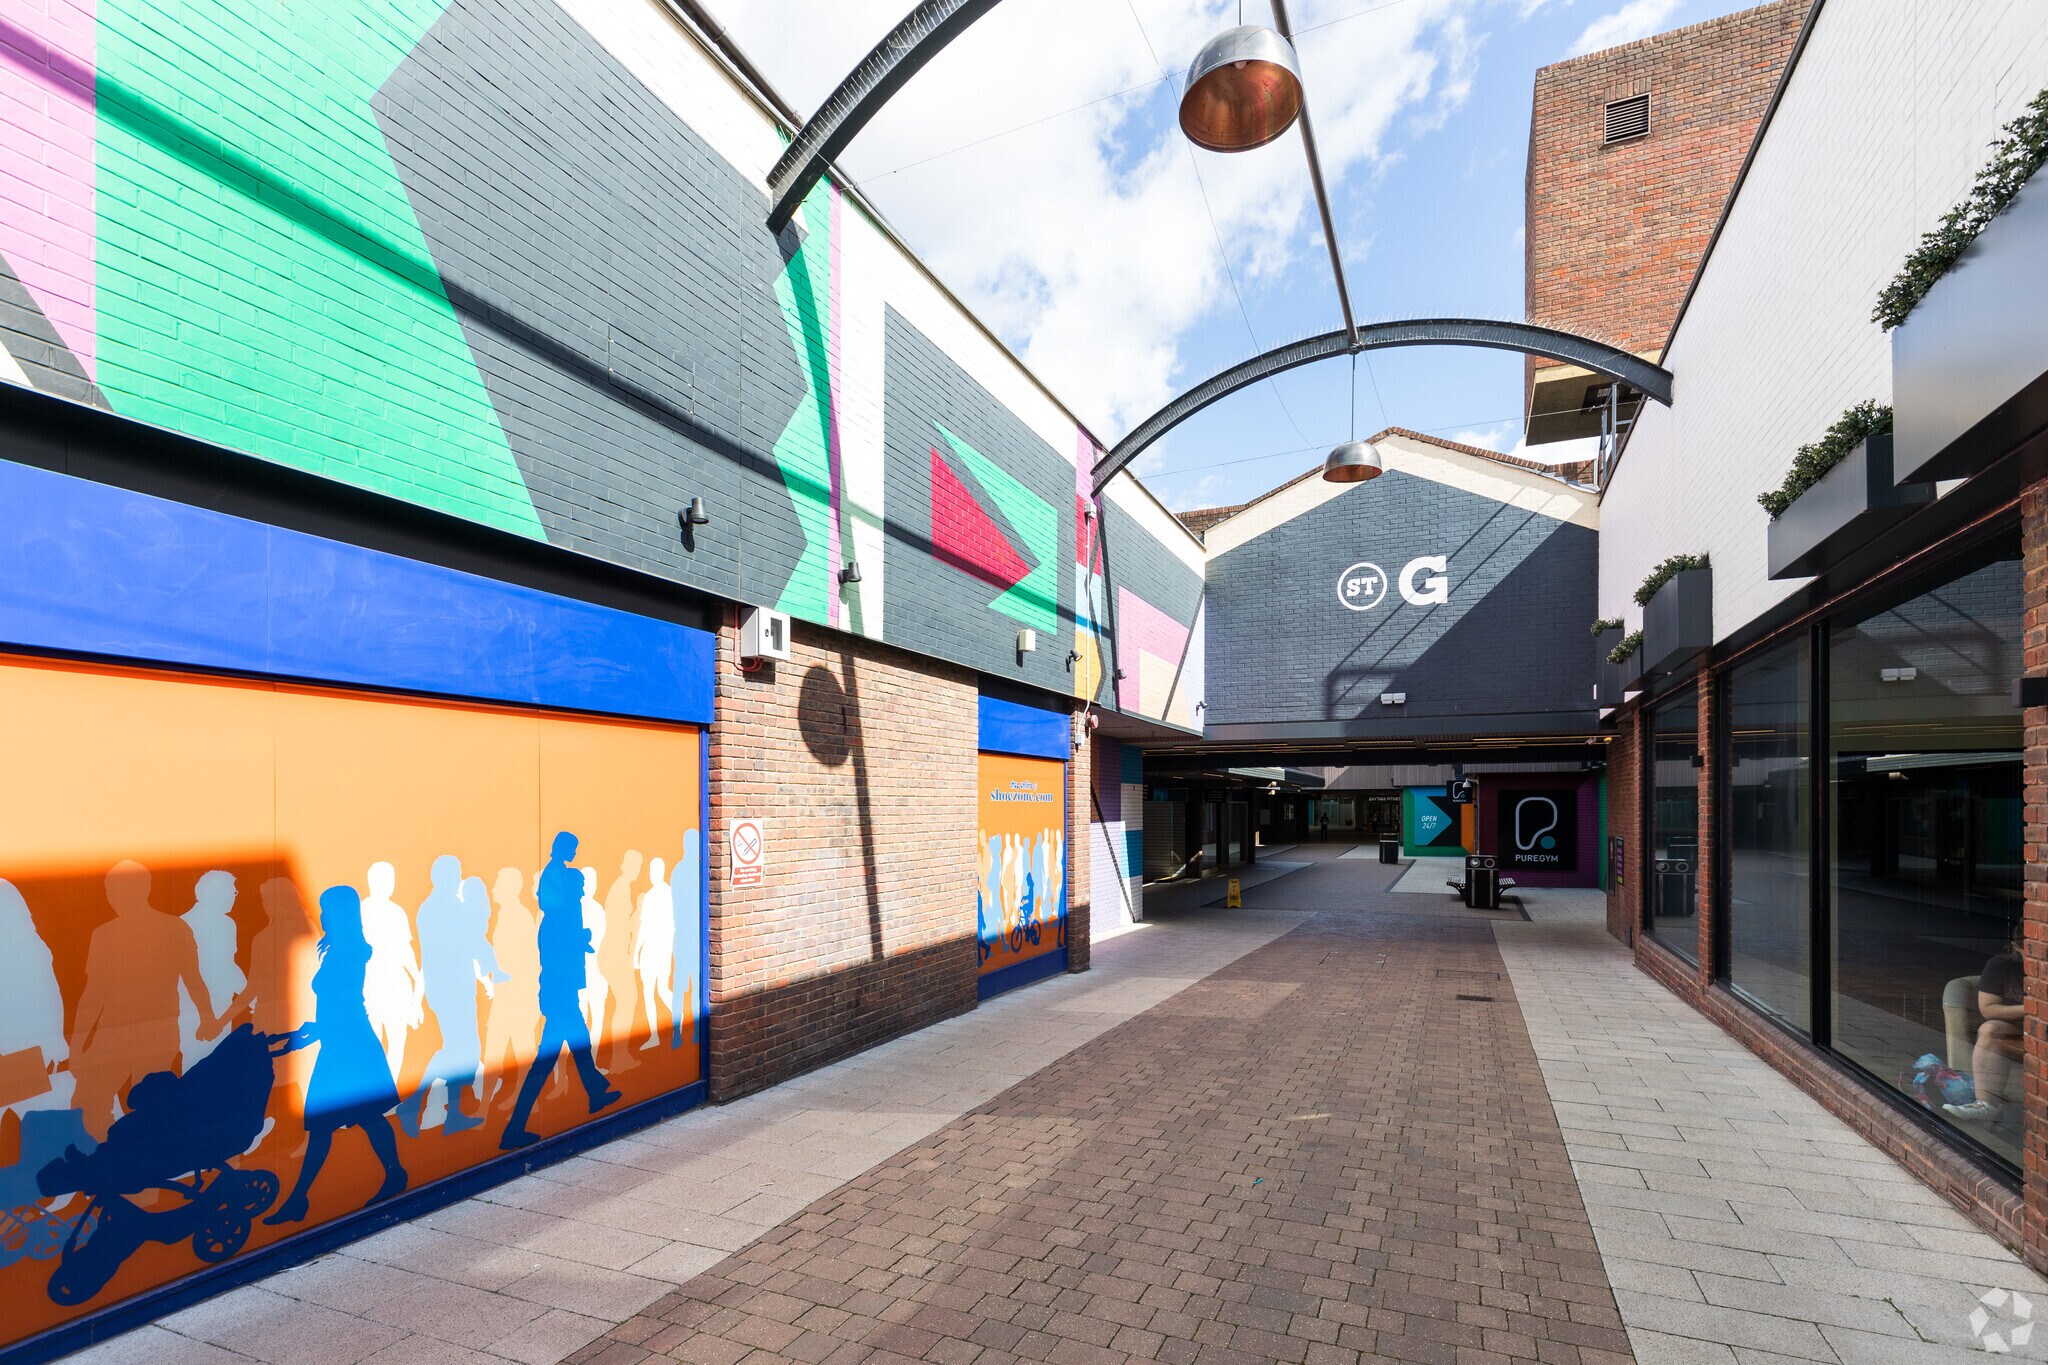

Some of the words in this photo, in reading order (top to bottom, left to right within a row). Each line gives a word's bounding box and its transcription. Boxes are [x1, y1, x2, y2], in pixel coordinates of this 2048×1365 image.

[1346, 577, 1378, 597] ST
[1398, 555, 1448, 606] G
[990, 788, 1053, 802] shoezone.com
[1515, 854, 1559, 863] PUREGYM
